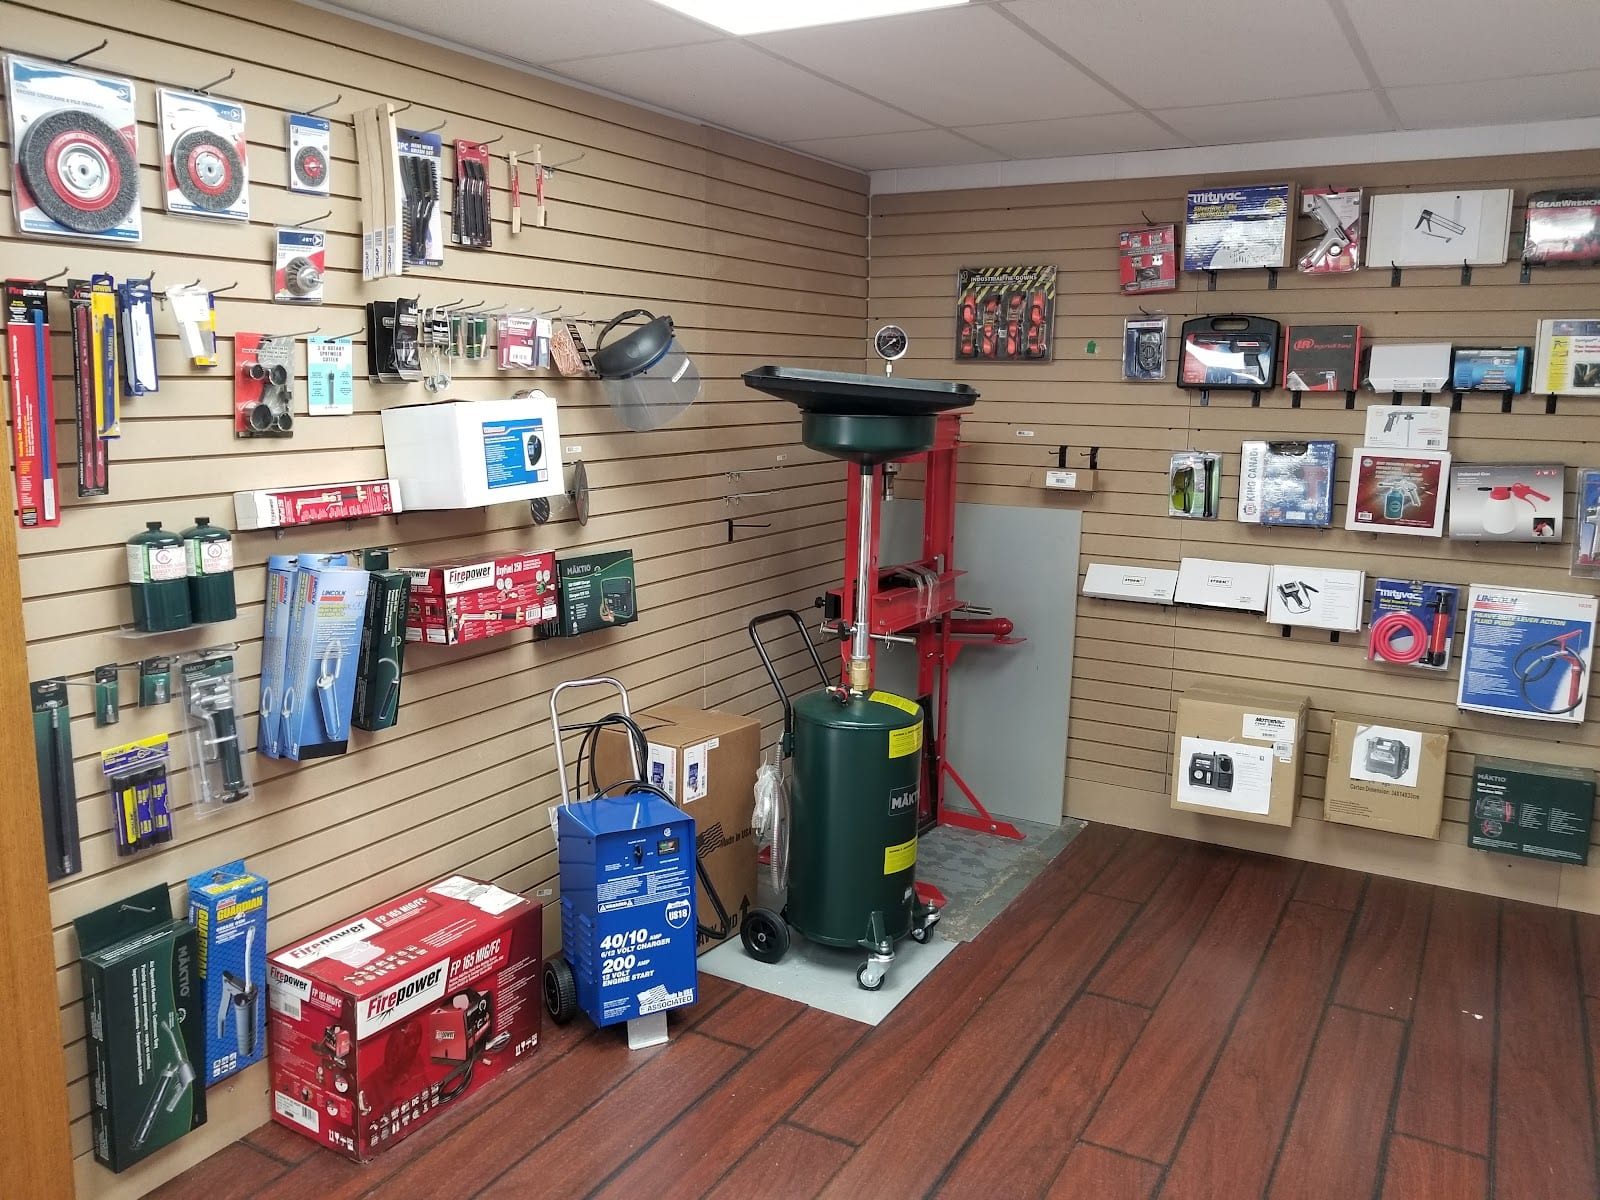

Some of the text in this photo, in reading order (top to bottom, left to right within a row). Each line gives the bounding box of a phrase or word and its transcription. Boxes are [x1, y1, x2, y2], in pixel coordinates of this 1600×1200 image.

[1188, 191, 1247, 204] mityvac
[1246, 481, 1257, 502] KING
[449, 566, 491, 583] Firepower
[566, 564, 592, 575] MÄKTIO
[1376, 588, 1423, 600] mityvac
[1476, 594, 1518, 604] LINCOLN
[1539, 618, 1566, 626] ACTION
[1477, 773, 1506, 782] MÄKTIO
[1350, 783, 1366, 792] Carton
[217, 896, 263, 923] GUARDIAN
[668, 908, 688, 920] US18
[289, 897, 428, 959] Firepower FP 165 MIG/FC
[198, 909, 208, 979] GUARDIAN
[600, 928, 662, 950] 40/10 AMP
[600, 937, 671, 959] 6/12 VOLT CHARGER
[450, 960, 462, 978] FP
[462, 952, 476, 971] 165
[475, 938, 501, 967] MIG/FC
[602, 954, 650, 975] 200 AMP
[178, 945, 190, 998] MÄKTIO
[270, 966, 308, 991] Firepower
[602, 969, 631, 982] 12 VOLT
[602, 969, 655, 987] ENGINE START
[367, 966, 442, 1019] Firepower
[647, 996, 692, 1011] ASSOCIATED
